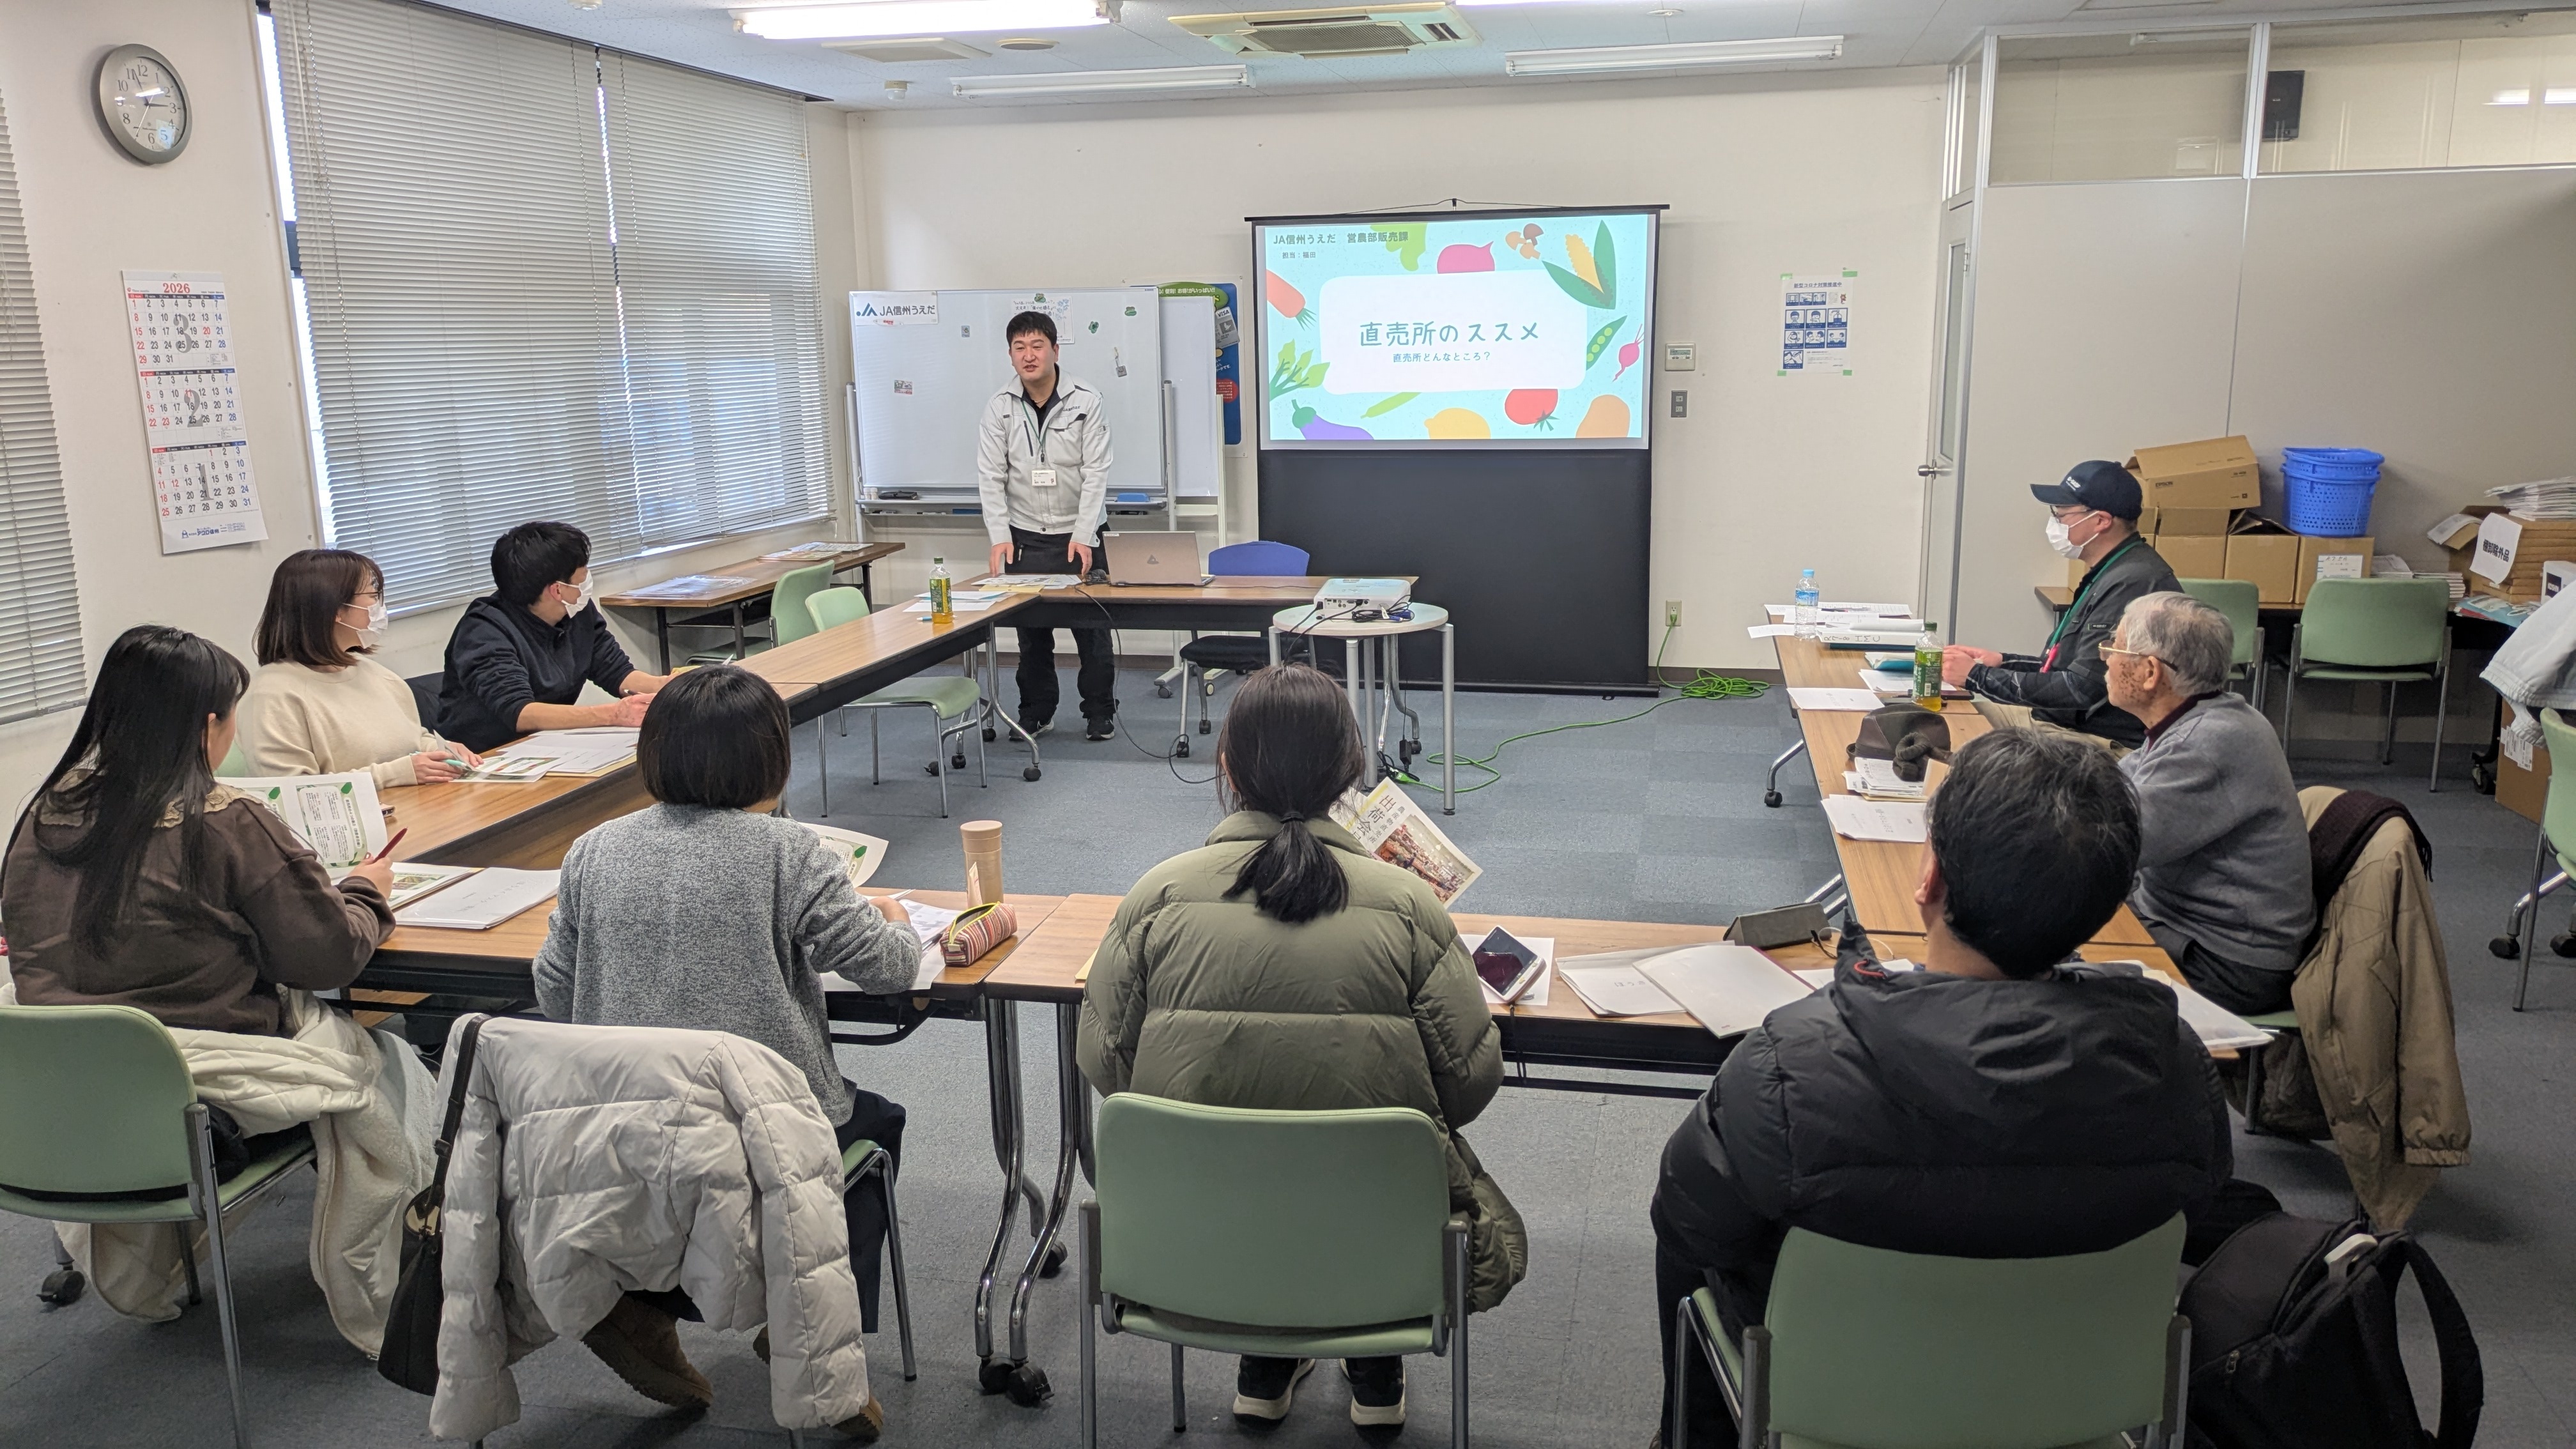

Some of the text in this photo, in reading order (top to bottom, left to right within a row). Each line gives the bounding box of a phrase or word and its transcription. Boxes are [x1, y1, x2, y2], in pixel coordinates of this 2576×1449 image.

[137, 65, 148, 77] 12
[155, 73, 159, 83] 1
[118, 80, 128, 91] 10
[164, 87, 171, 98] 2
[169, 103, 177, 114] 3
[123, 113, 130, 124] 8
[168, 119, 175, 129] 4
[148, 133, 155, 144] 6
[160, 130, 168, 141] 5
[1273, 232, 1409, 244] JA信州うえだ 営農部販売課
[163, 283, 190, 293] 2026
[880, 305, 935, 316] JA信州うえだ
[1360, 321, 1538, 346] 直売所のススメ
[1393, 351, 1491, 363] 直売所どんなところ？
